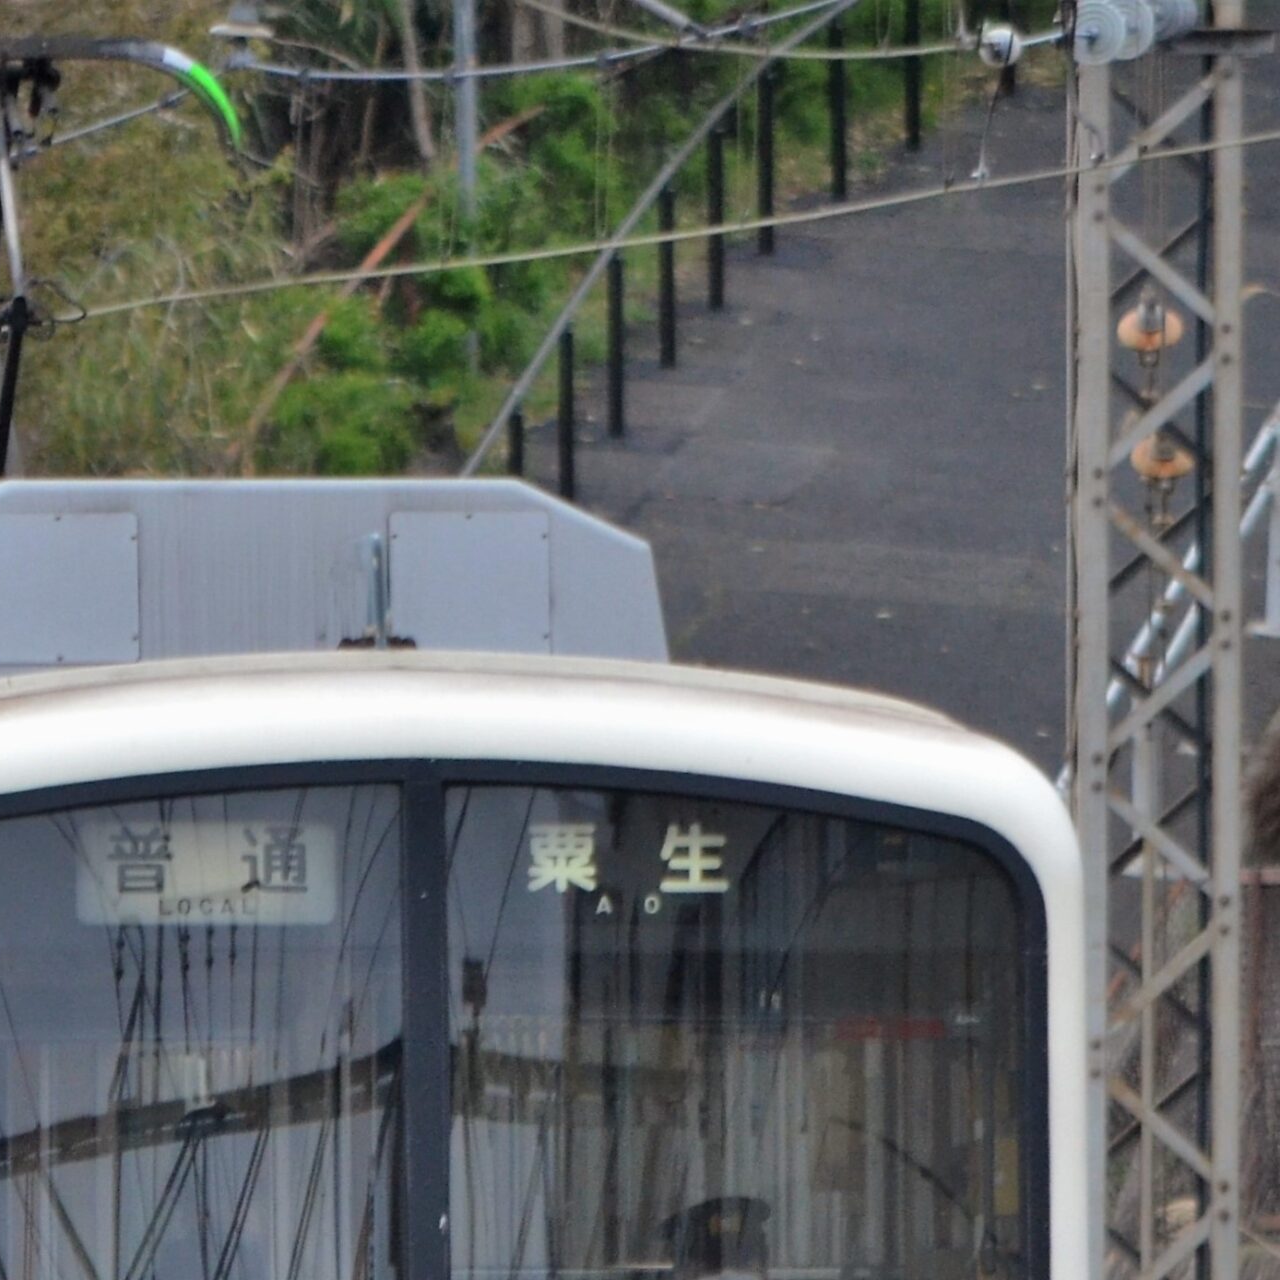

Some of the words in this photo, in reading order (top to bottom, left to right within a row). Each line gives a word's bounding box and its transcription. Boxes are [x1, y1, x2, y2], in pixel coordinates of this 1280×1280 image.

[107, 826, 308, 893] 普通
[528, 823, 729, 893] 粟生
[159, 899, 258, 916] LOCAL
